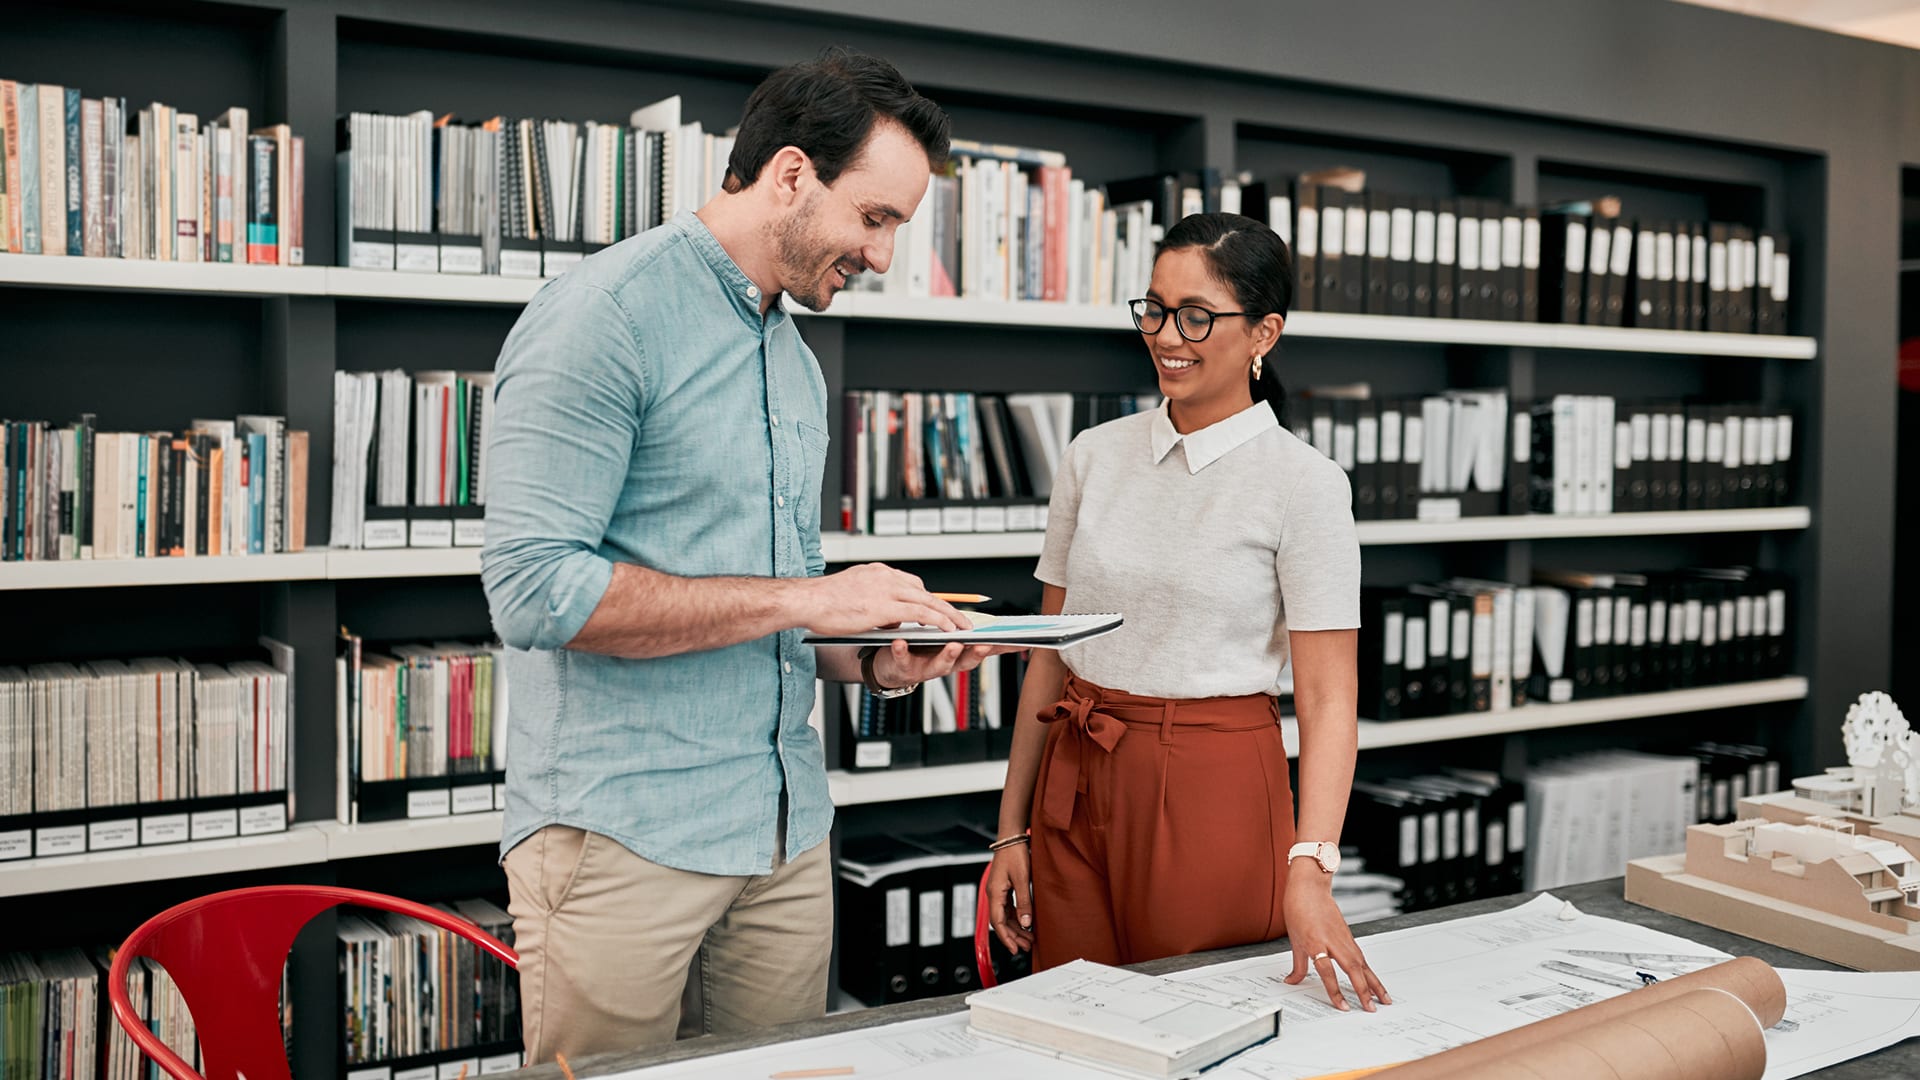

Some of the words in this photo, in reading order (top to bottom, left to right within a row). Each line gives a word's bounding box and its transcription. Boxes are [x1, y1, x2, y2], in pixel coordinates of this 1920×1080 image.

[46, 111, 57, 150] HISTORY
[47, 167, 60, 239] ARCHITECTURE
[68, 165, 80, 212] CORREA
